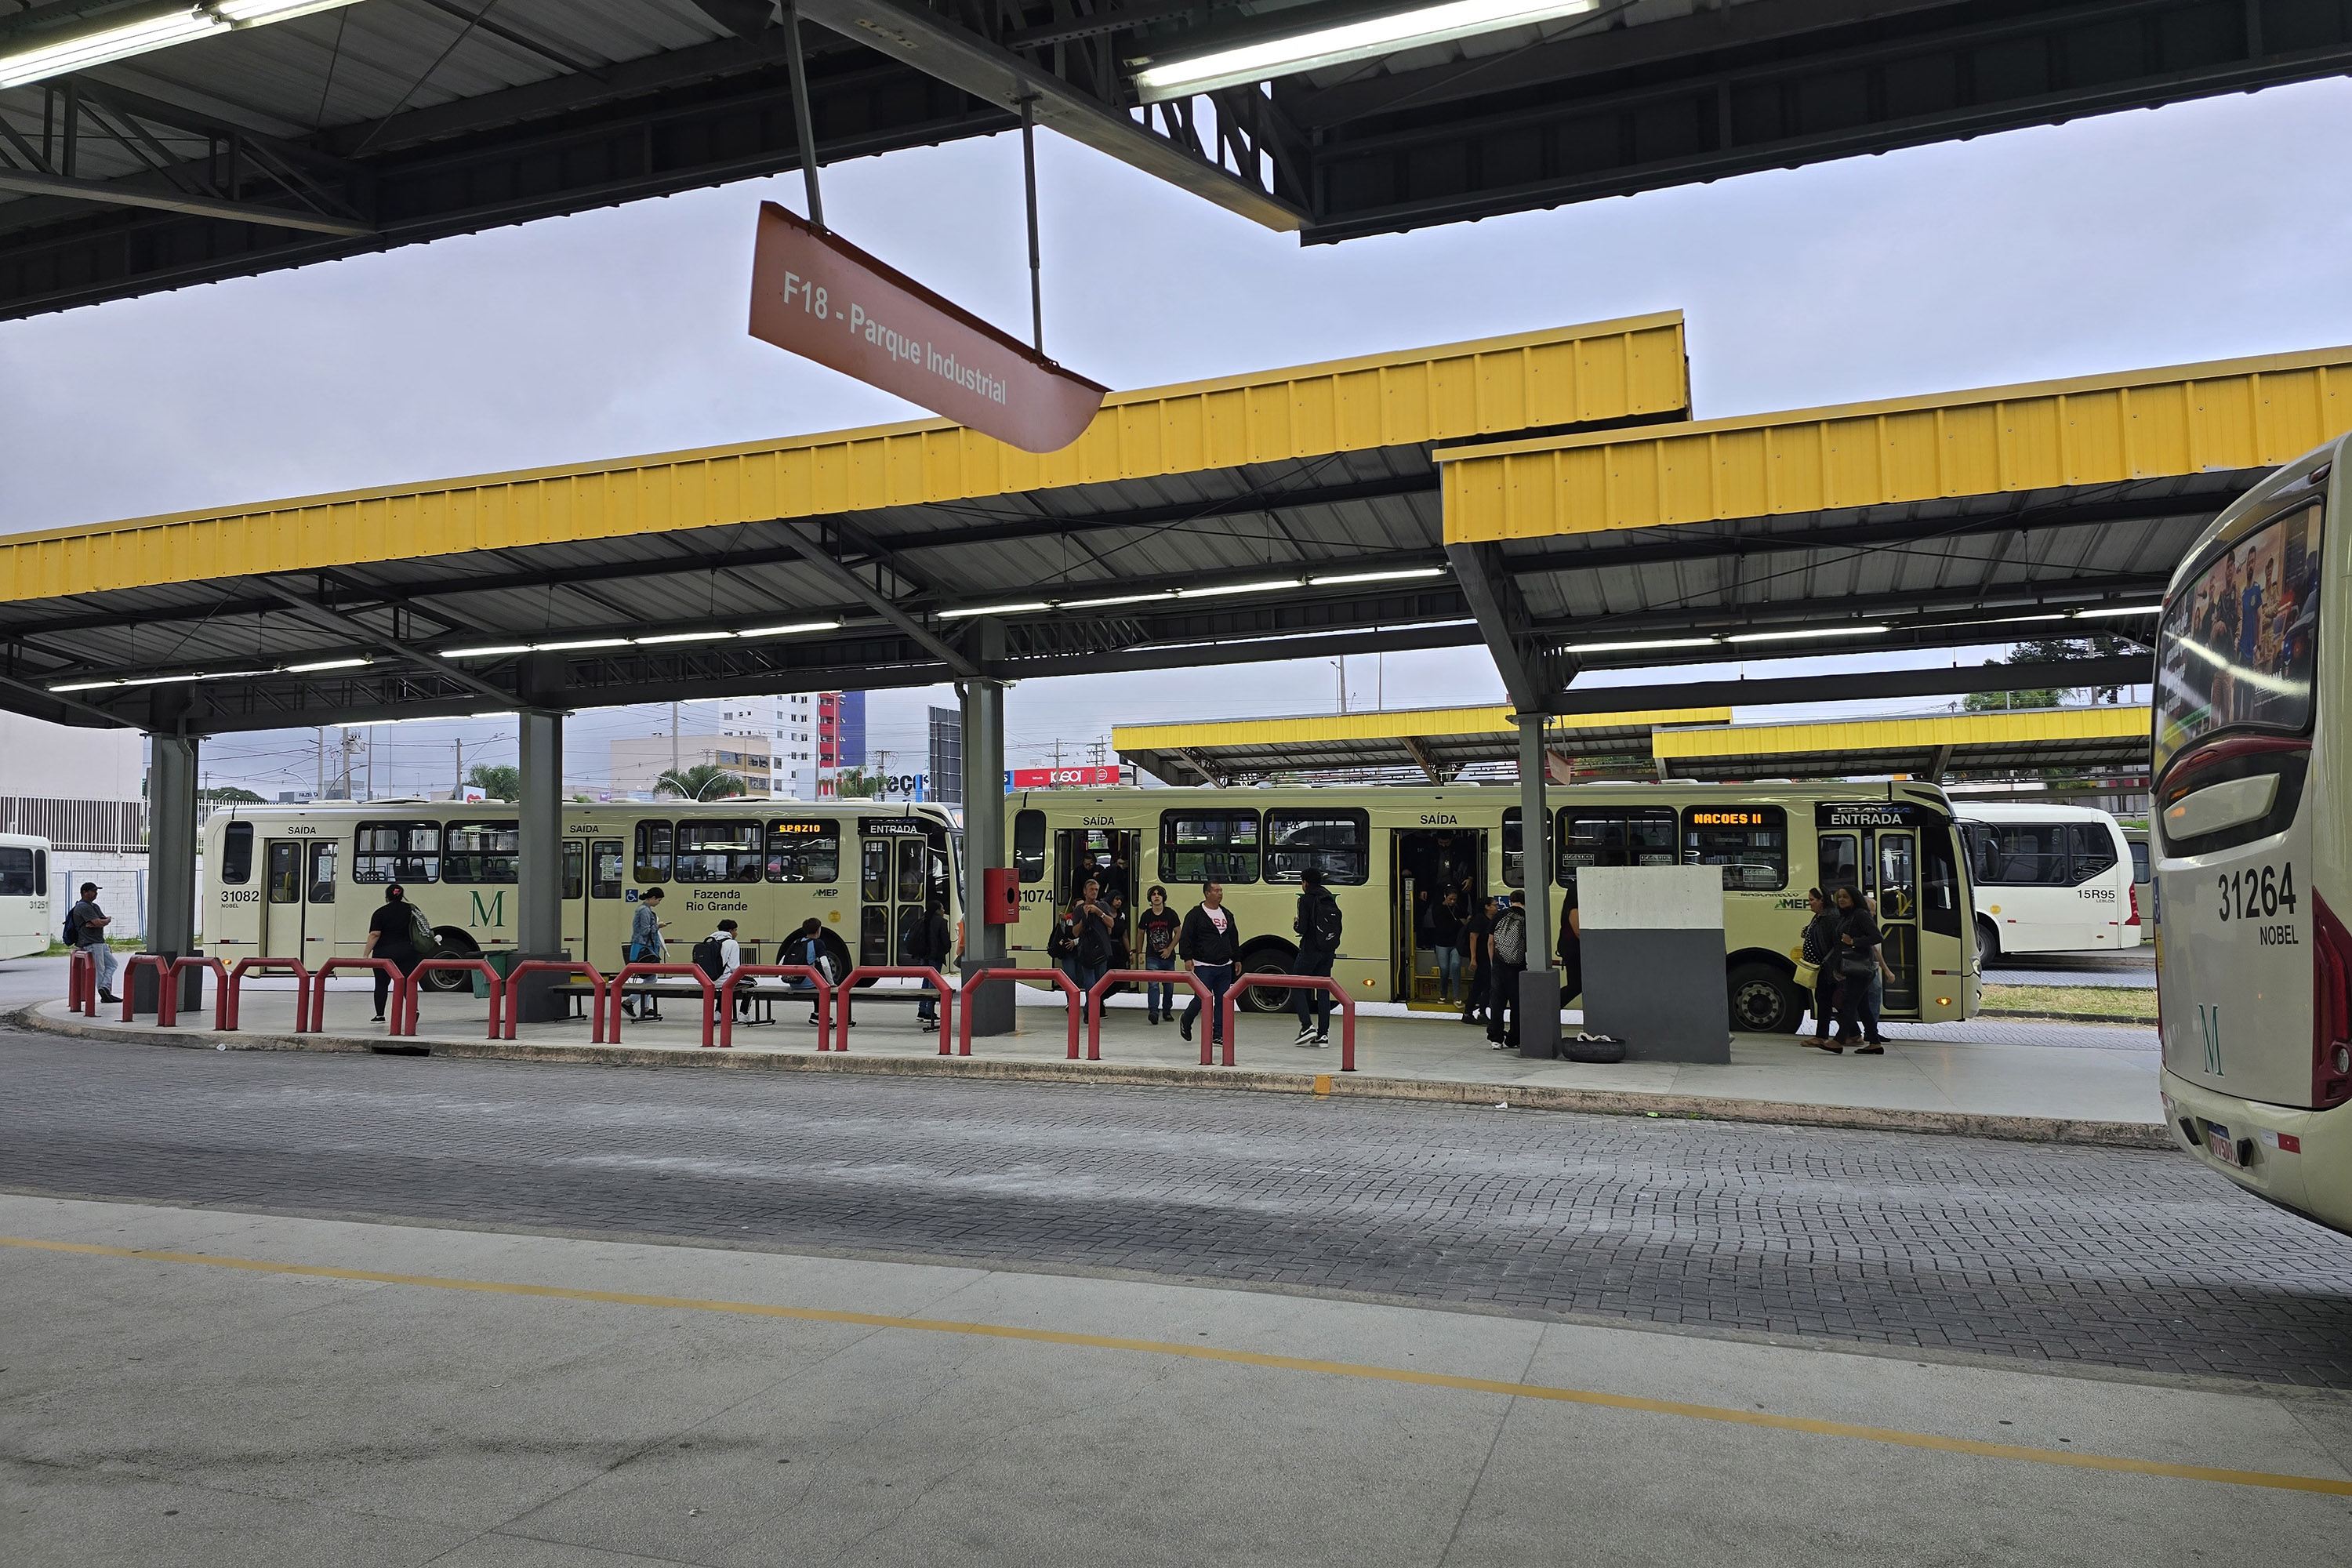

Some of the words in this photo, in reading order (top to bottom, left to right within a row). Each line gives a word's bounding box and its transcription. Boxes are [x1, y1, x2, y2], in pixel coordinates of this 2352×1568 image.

[784, 270, 828, 320] F18
[836, 311, 844, 320] -
[851, 303, 921, 364] Parque
[927, 342, 1006, 405] Industrial
[1083, 814, 1115, 826] SAÍDA
[1420, 812, 1457, 824] SAÍDA
[1694, 814, 1748, 824] NACOES
[1752, 814, 1762, 824] II
[1831, 814, 1903, 825] ENTRADA
[288, 824, 317, 834] SAÍDA
[221, 891, 260, 902] 31082
[694, 889, 741, 898] Fazenda
[812, 888, 838, 897] AMEP
[2078, 890, 2115, 899] 15R95
[2218, 862, 2296, 922] 31264
[29, 901, 49, 909] 31251
[468, 890, 506, 927] M
[686, 902, 704, 911] Rio
[707, 902, 748, 911] Grande
[1210, 918, 1228, 928] SA
[2260, 925, 2299, 946] NOBEL
